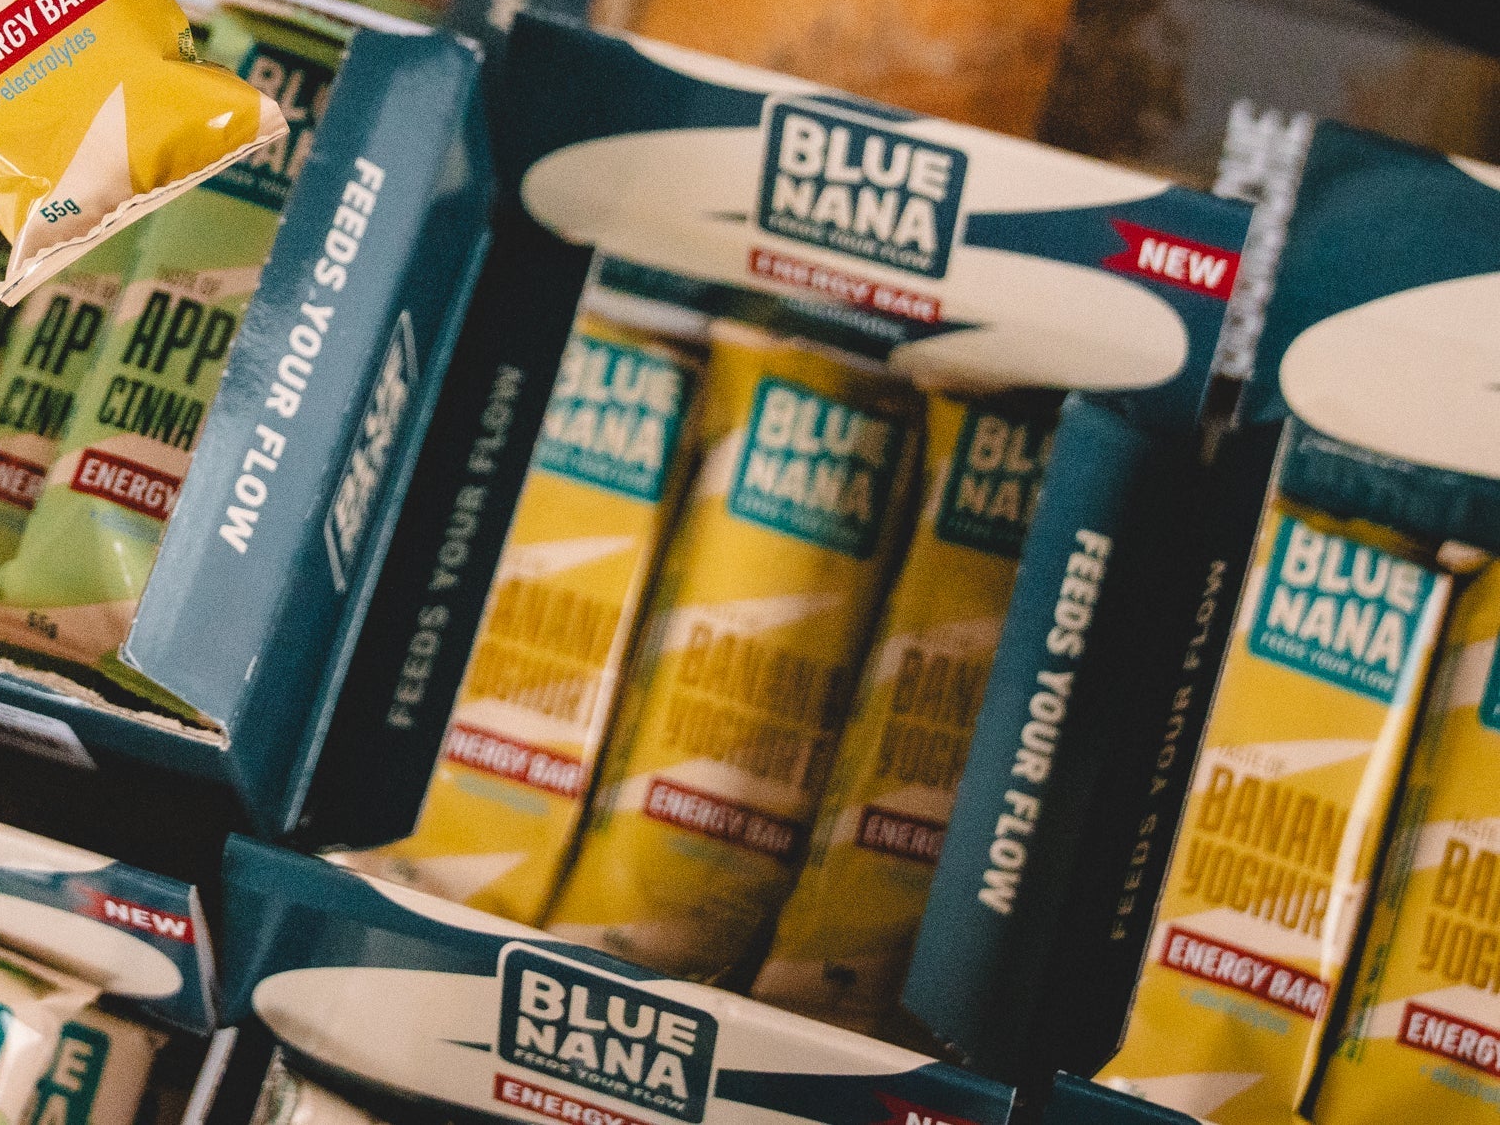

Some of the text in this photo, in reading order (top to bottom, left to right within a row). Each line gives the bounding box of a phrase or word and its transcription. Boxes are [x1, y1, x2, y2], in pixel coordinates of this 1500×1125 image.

[0, 26, 97, 101] electrolytes
[777, 113, 954, 203] BLUE
[40, 197, 82, 224] 55g
[315, 156, 387, 293] FEEDS
[771, 175, 938, 253] NANA
[1136, 236, 1229, 289] NEW
[121, 289, 238, 386] APP
[265, 298, 334, 419] YOUR
[96, 374, 207, 453] CINNA
[969, 415, 1053, 473] BL
[219, 423, 289, 554] FLOW
[1280, 520, 1422, 613] BLUE
[1266, 582, 1405, 675] NANA
[446, 727, 528, 778] NERGY
[977, 528, 1114, 916] FEEDS YOUR FLOW
[1198, 763, 1368, 883] BANAN
[103, 898, 187, 938] NEW
[518, 969, 700, 1056] BLUE
[1168, 932, 1272, 995] ENERGY
[1268, 969, 1327, 1014] BAR
[515, 1016, 690, 1100] NANA
[1404, 1010, 1500, 1072] ENERG
[500, 1080, 626, 1125] ENERGY
